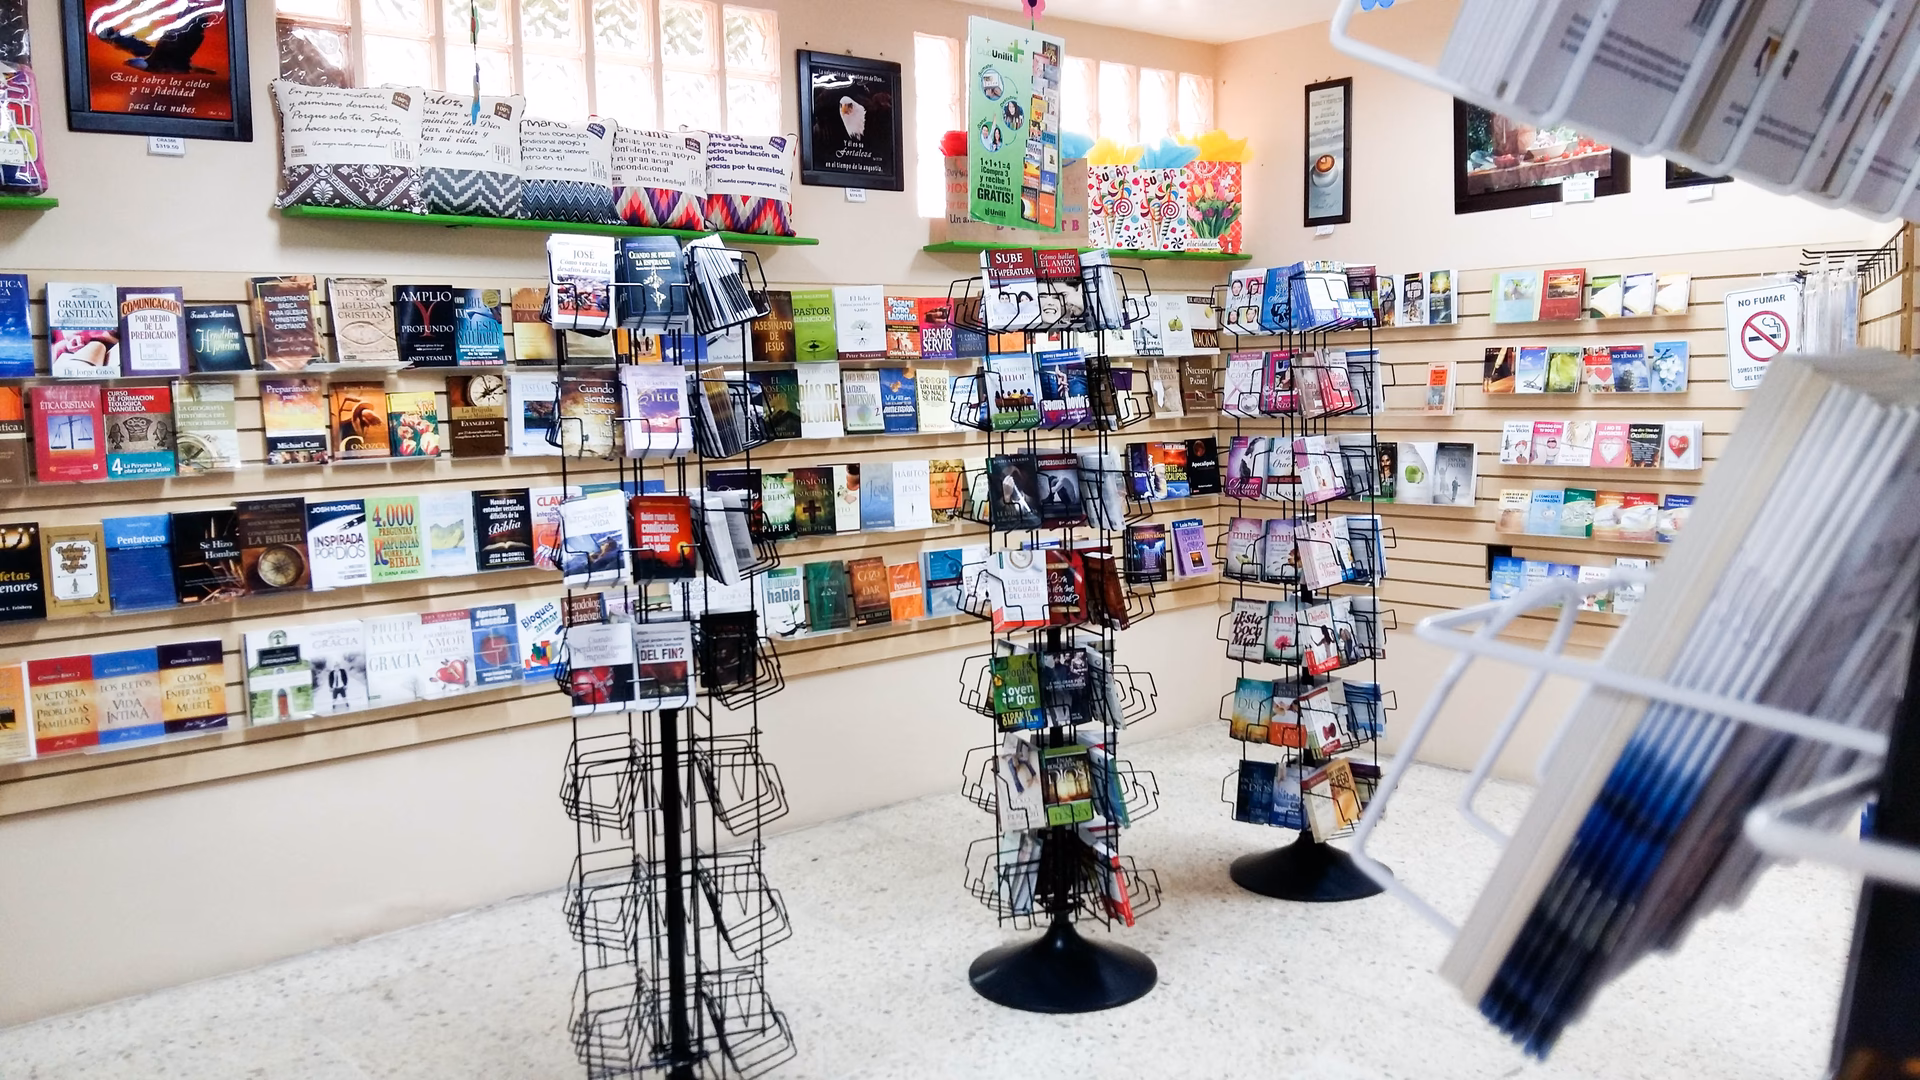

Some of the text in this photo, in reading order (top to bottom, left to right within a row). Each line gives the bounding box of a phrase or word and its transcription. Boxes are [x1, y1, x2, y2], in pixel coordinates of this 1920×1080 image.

[992, 50, 1012, 62] Unilit
[110, 72, 210, 88] Está sobre los cielos
[140, 86, 195, 97] tu fidelidad
[129, 103, 149, 112] pasa
[153, 102, 165, 112] las
[170, 104, 197, 114] nubes.
[292, 110, 327, 122] Porque
[329, 112, 347, 120] solo
[305, 124, 330, 132] haces
[735, 149, 770, 157] bendición
[836, 148, 872, 158] Fortaleza
[986, 176, 1004, 184] recibe
[1008, 177, 1010, 185] 1
[978, 188, 1013, 204] GRATIS!
[573, 250, 594, 259] JOSÉ
[629, 251, 650, 259] CUANDO
[996, 252, 1023, 264] SUBE
[643, 258, 671, 266] ESPERANZA
[989, 268, 1034, 277] TEMPERATURA
[400, 291, 452, 302] AMPLIO
[1738, 294, 1785, 307] NO FUMAR
[59, 300, 112, 309] GRAMATICA
[58, 310, 113, 318] CASTELLANA
[284, 308, 308, 316] IGLESIAS
[338, 311, 391, 320] CRISTIANA
[794, 307, 830, 316] PASTOR
[274, 322, 306, 330] CRISTIANOS
[402, 324, 454, 334] PROFUNDO
[754, 321, 792, 331] ASESINATO
[770, 332, 779, 342] DE
[923, 338, 952, 353] SERVIR
[428, 354, 452, 362] STANLEY
[1190, 377, 1208, 385] PADRE!
[266, 384, 319, 394] Preparándose
[579, 383, 614, 394] Cuando
[825, 383, 838, 400] DE
[61, 400, 95, 409] CRISTIANA
[584, 403, 615, 415] deseos
[800, 402, 841, 424] GLORIA
[277, 440, 320, 449] Michael Catt
[112, 458, 123, 475] 4
[1192, 460, 1215, 468] Apocalipsis
[372, 503, 414, 528] 4.000
[489, 520, 521, 536] Biblia
[641, 524, 679, 533] condiciones
[117, 534, 165, 545] Pentateuco
[248, 533, 305, 545] LA BIBLIA
[314, 533, 364, 547] INSPIRADA
[1233, 531, 1260, 542] mujer
[1271, 535, 1294, 545] muje
[200, 540, 233, 549] Se Hizo
[205, 550, 240, 559] Hombre
[315, 543, 366, 560] POR DIOS
[389, 557, 421, 568] BIBLIA
[862, 585, 880, 595] DAR
[767, 588, 800, 604] habla
[476, 608, 507, 619] Aprenda
[520, 601, 555, 629] Bloques
[1233, 610, 1262, 626] ¡Esta
[372, 621, 413, 634] PHILIP
[533, 611, 560, 633] armar
[1232, 622, 1262, 635] boca
[312, 637, 359, 649] GRACIA
[371, 632, 414, 646] YANCEY
[426, 635, 465, 648] AMOR
[640, 648, 685, 661] DEL FIN?
[369, 653, 422, 672] GRACIA
[177, 673, 207, 683] COMO
[101, 680, 152, 694] LOS RETOS
[36, 688, 86, 701] VICTORIA
[166, 686, 221, 700] ENFERMEDAD
[113, 699, 143, 711] VIDA
[1017, 695, 1035, 705] Ora
[1238, 697, 1266, 710] DIOS
[37, 704, 89, 719] PROBLEMAS
[176, 700, 213, 713] MUERTE
[38, 716, 91, 732] FAMILIARES
